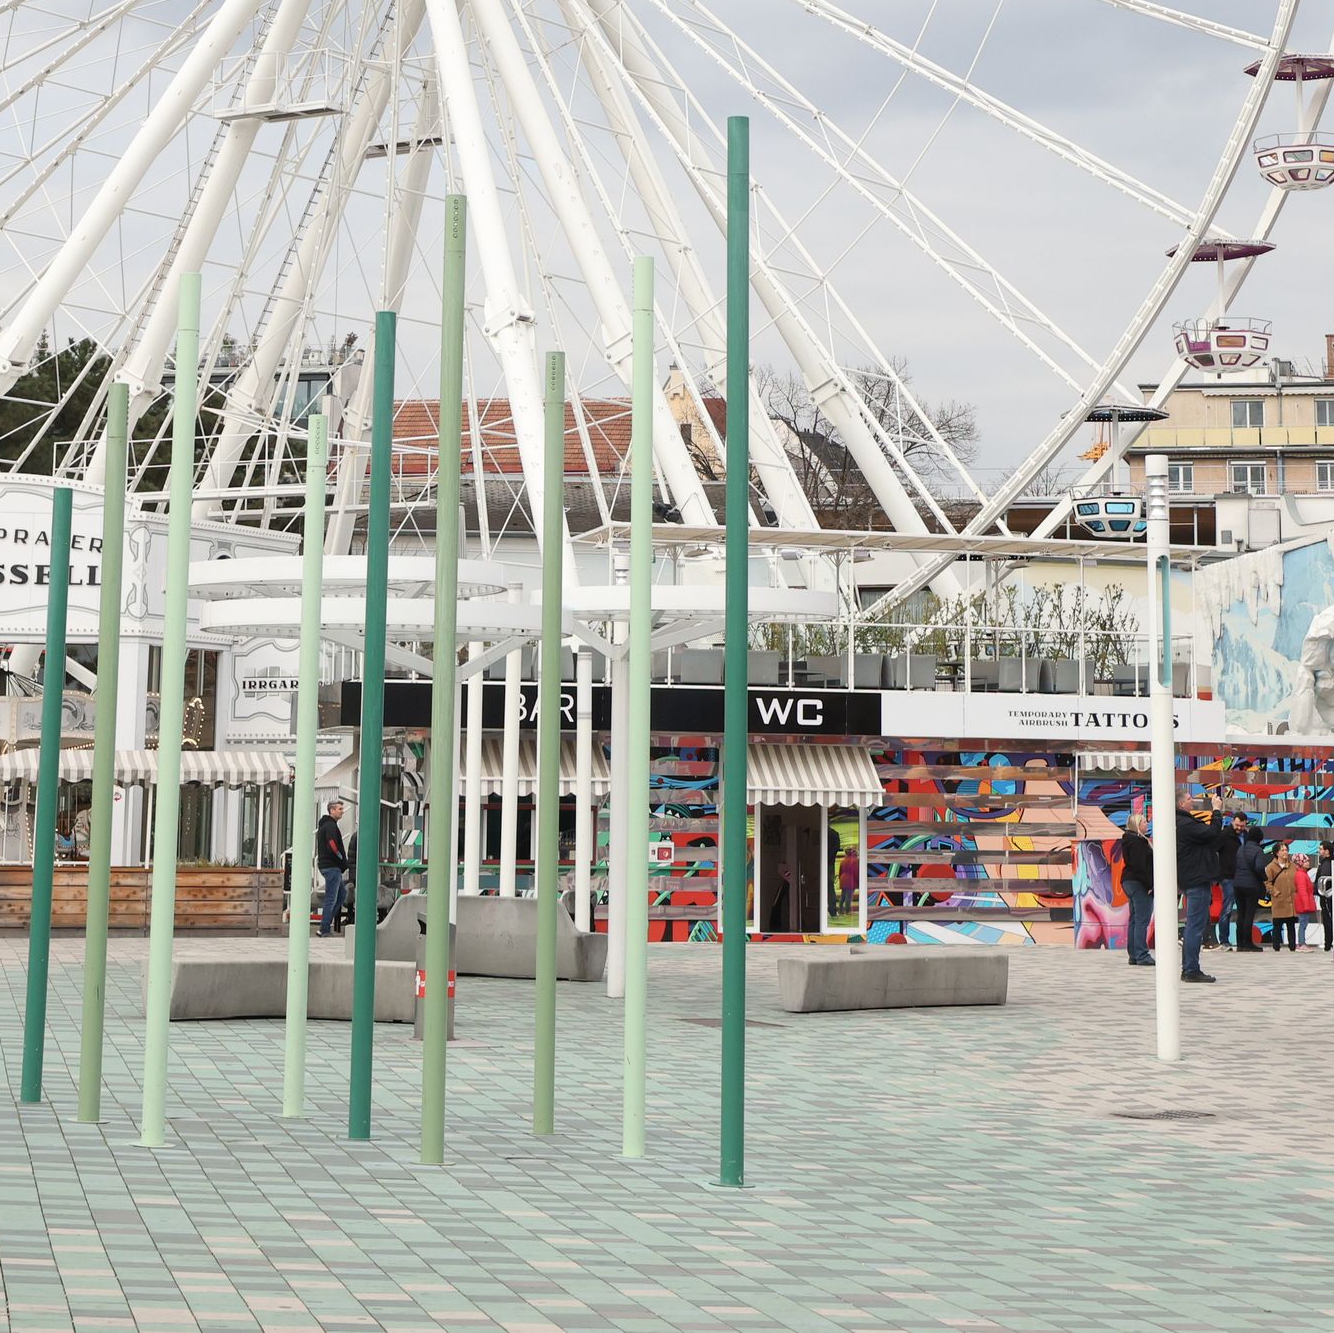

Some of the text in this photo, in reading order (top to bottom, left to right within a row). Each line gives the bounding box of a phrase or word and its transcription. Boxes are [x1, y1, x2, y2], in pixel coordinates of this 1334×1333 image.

[242, 680, 299, 689] IRRGAR
[756, 697, 823, 726] WC
[1008, 710, 1068, 719] TEMPORARY
[1019, 719, 1068, 727] AIRBRUSH
[1070, 712, 1179, 729] TATTOS
